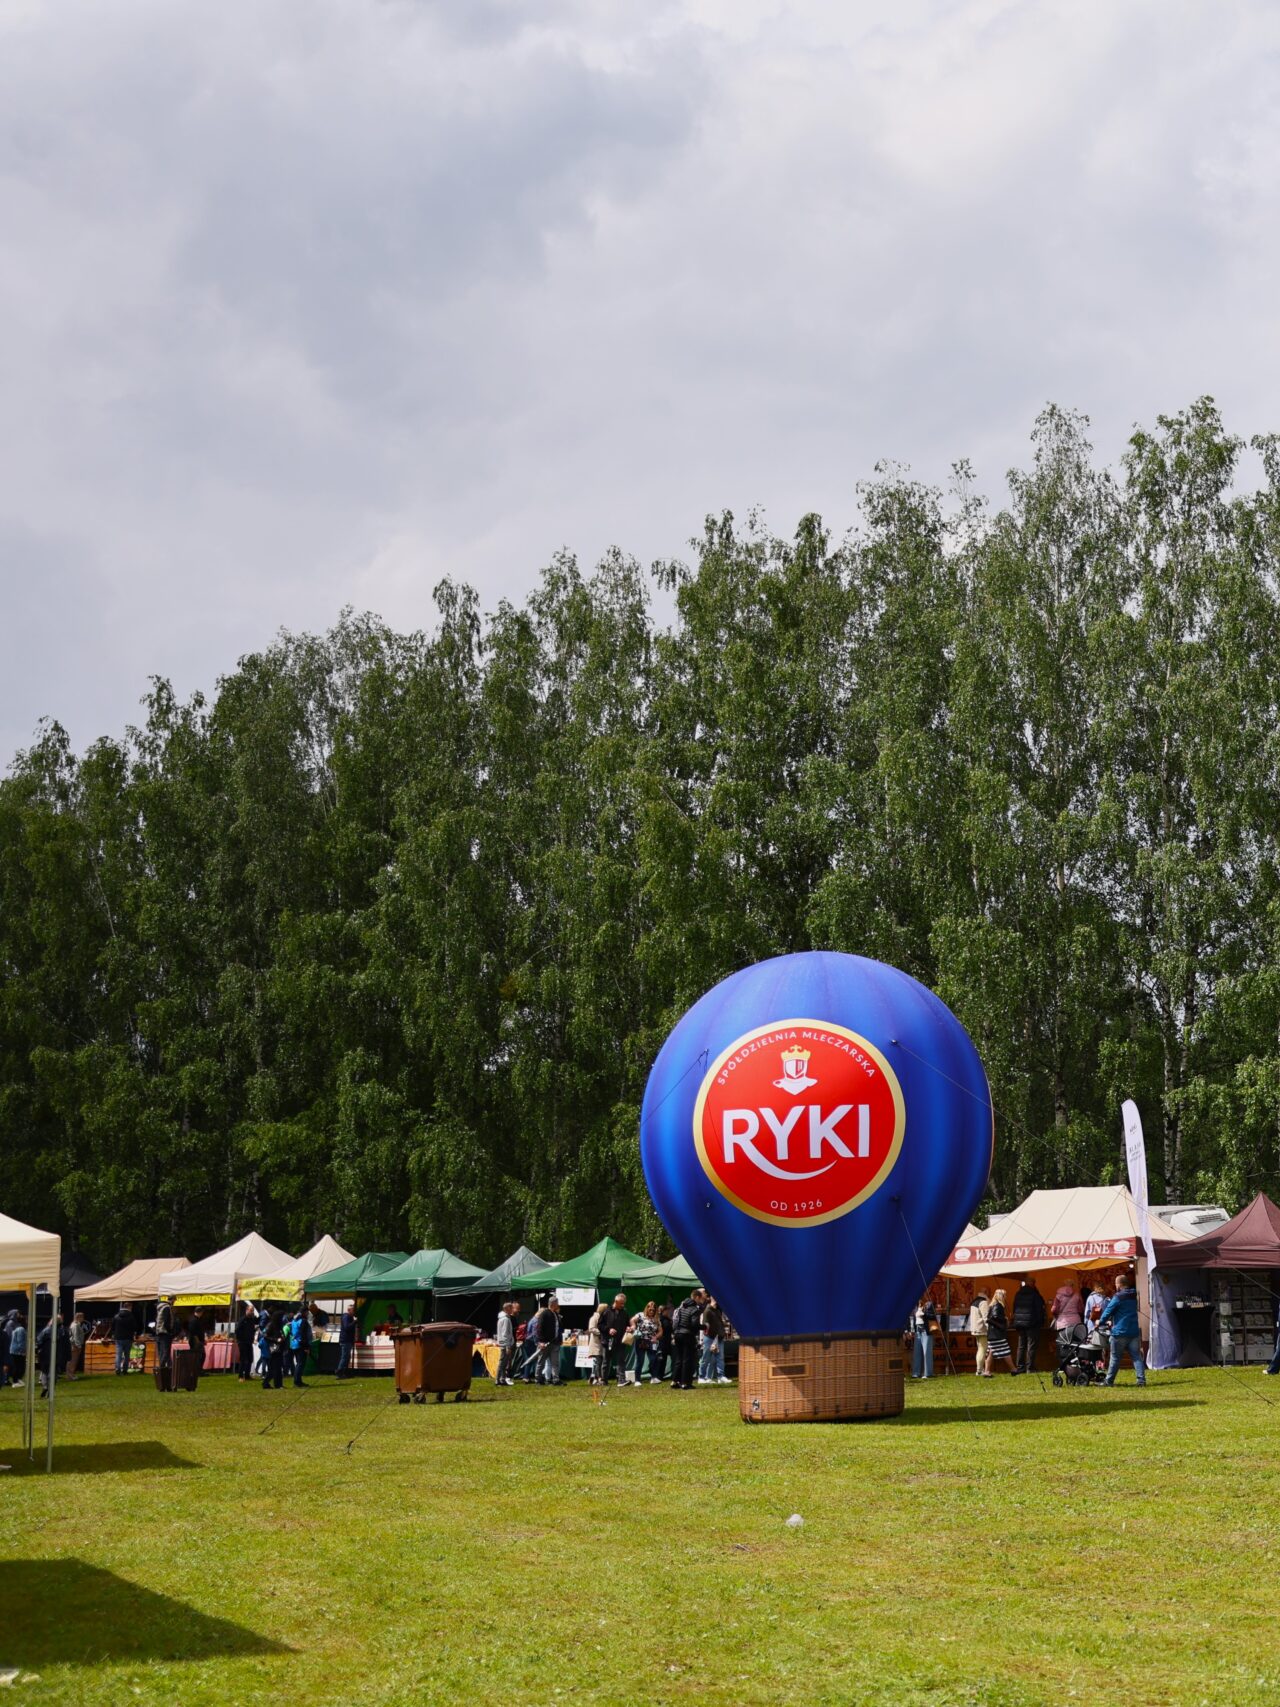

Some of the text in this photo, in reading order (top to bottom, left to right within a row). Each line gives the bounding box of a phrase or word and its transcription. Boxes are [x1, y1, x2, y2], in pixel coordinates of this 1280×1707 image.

[717, 1031, 876, 1086] SPÓŁDZIELNIA MLECZARSKA
[722, 1104, 870, 1181] RYKI
[770, 1199, 823, 1212] OD 1926
[975, 1242, 1110, 1262] WĘDLINY TRADYCYJNE
